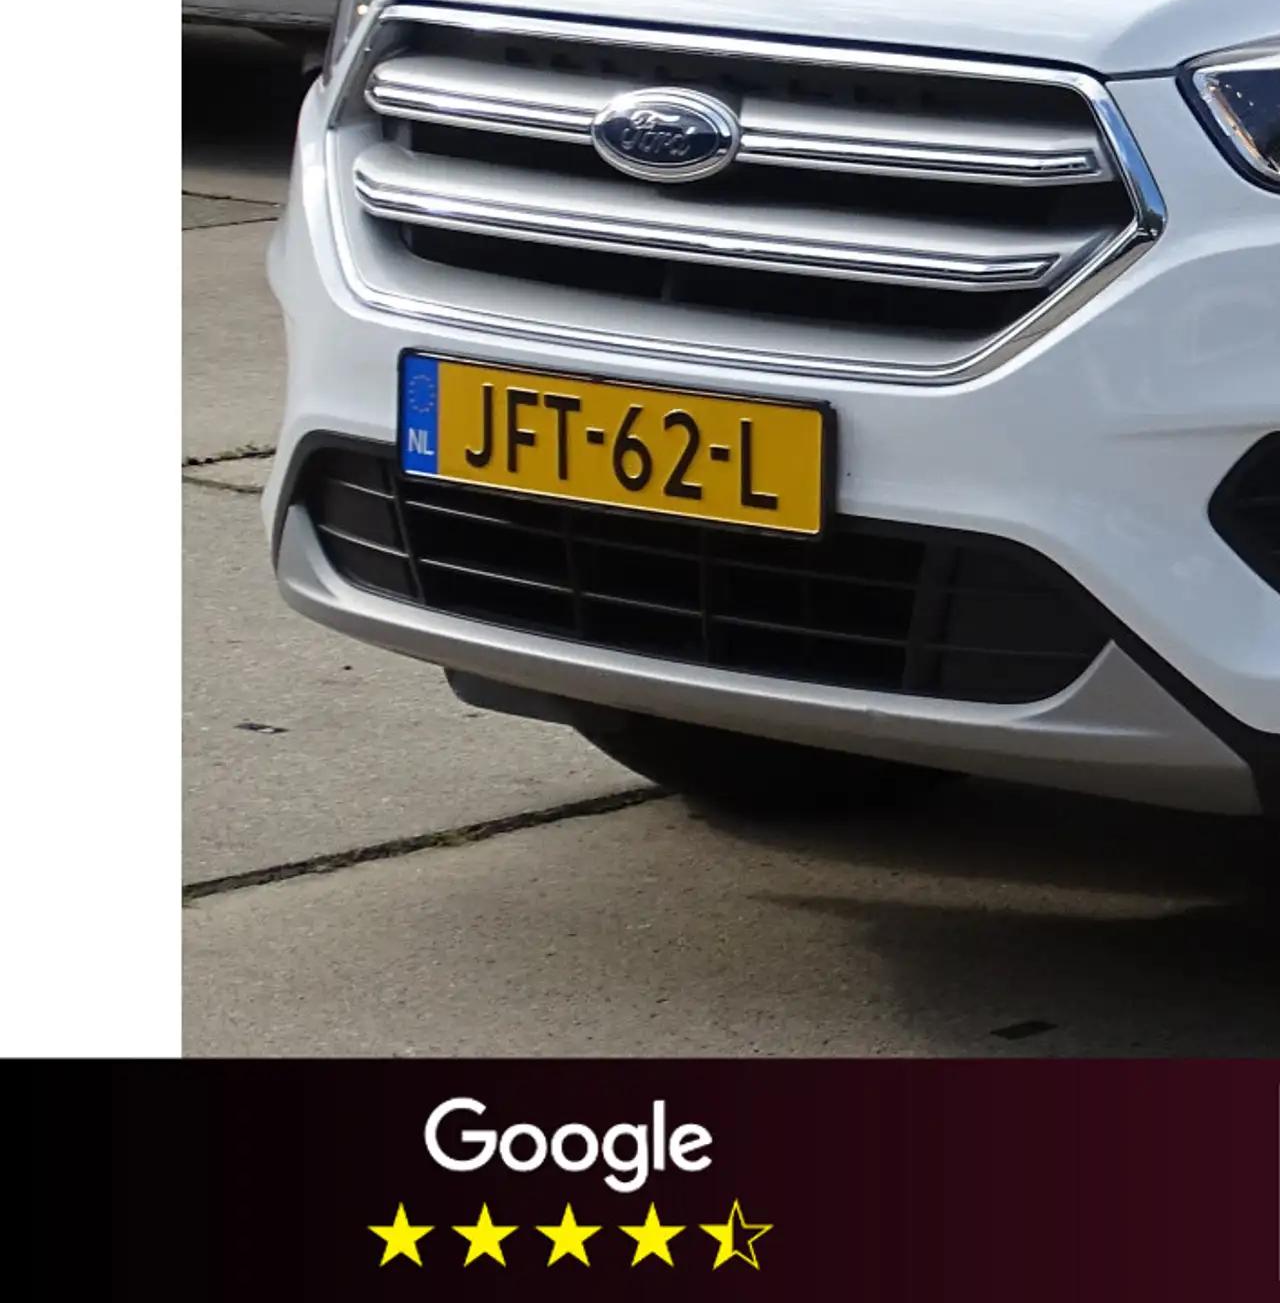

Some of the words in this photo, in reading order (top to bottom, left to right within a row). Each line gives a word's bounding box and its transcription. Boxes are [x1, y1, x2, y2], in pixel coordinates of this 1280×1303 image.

[621, 109, 697, 156] Ford
[408, 429, 434, 455] NL
[465, 383, 779, 510] JFT-62-L
